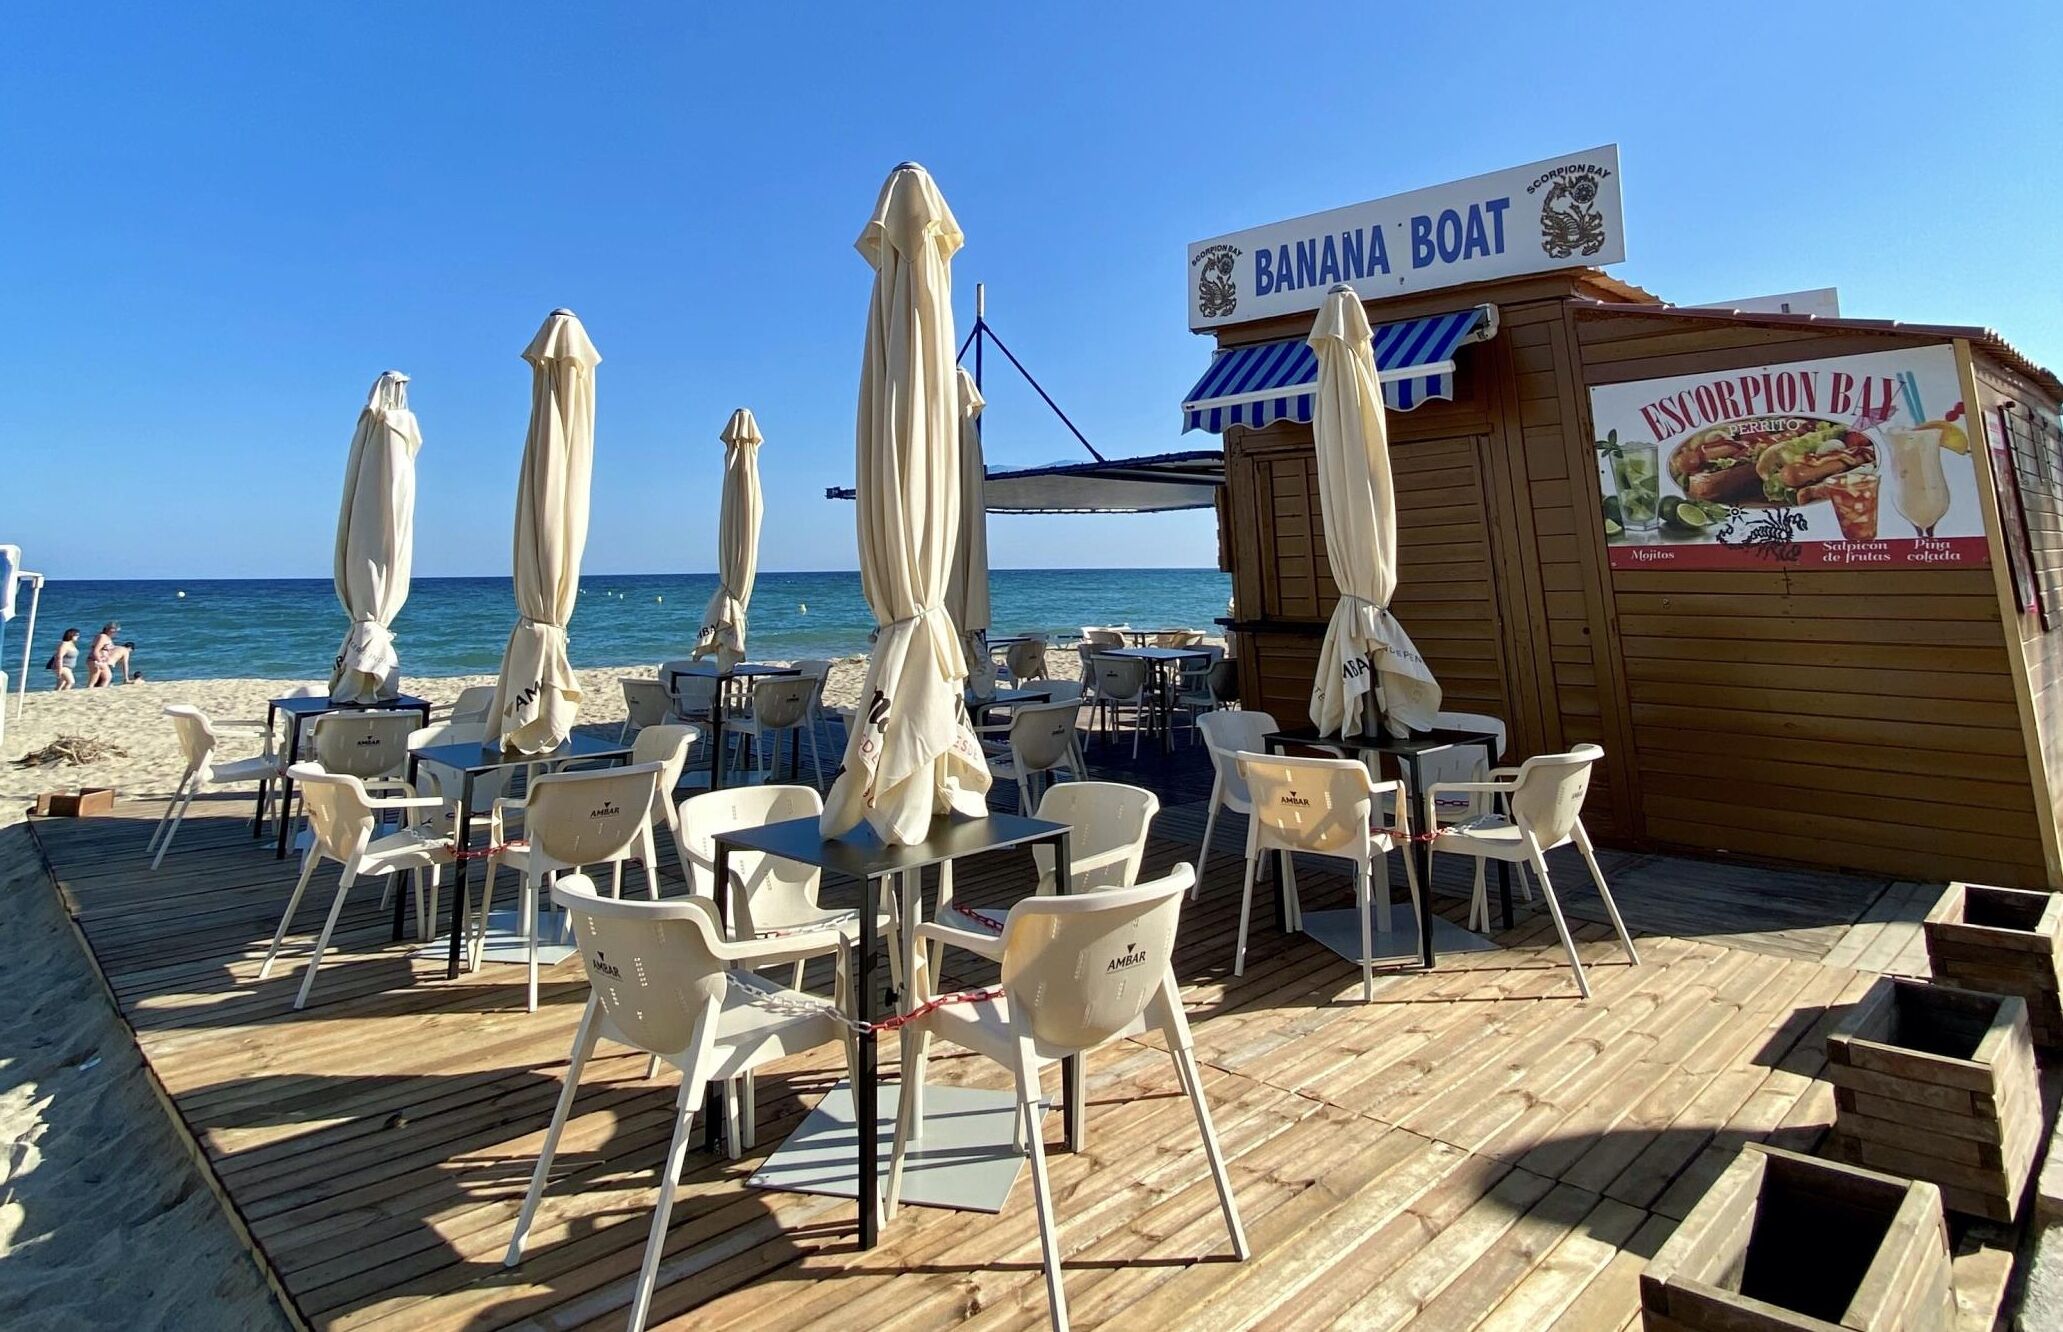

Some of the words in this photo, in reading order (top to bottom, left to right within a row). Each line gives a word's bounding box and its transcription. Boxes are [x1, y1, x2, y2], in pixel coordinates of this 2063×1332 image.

[1526, 164, 1586, 195] SCORPION
[1586, 164, 1612, 179] BAY
[1255, 224, 1391, 296] BANANA
[1411, 197, 1510, 269] BOAT
[1639, 370, 1820, 443] ESCORPION
[1828, 372, 1907, 421] BAY
[1728, 419, 1801, 437] PERRITO
[1631, 549, 1675, 561] Mojitos
[1823, 552, 1841, 562] de
[1845, 551, 1892, 563] frutas
[1907, 550, 1961, 562] colada
[592, 958, 622, 979] AMBAR
[1106, 951, 1146, 972] AMBAR
